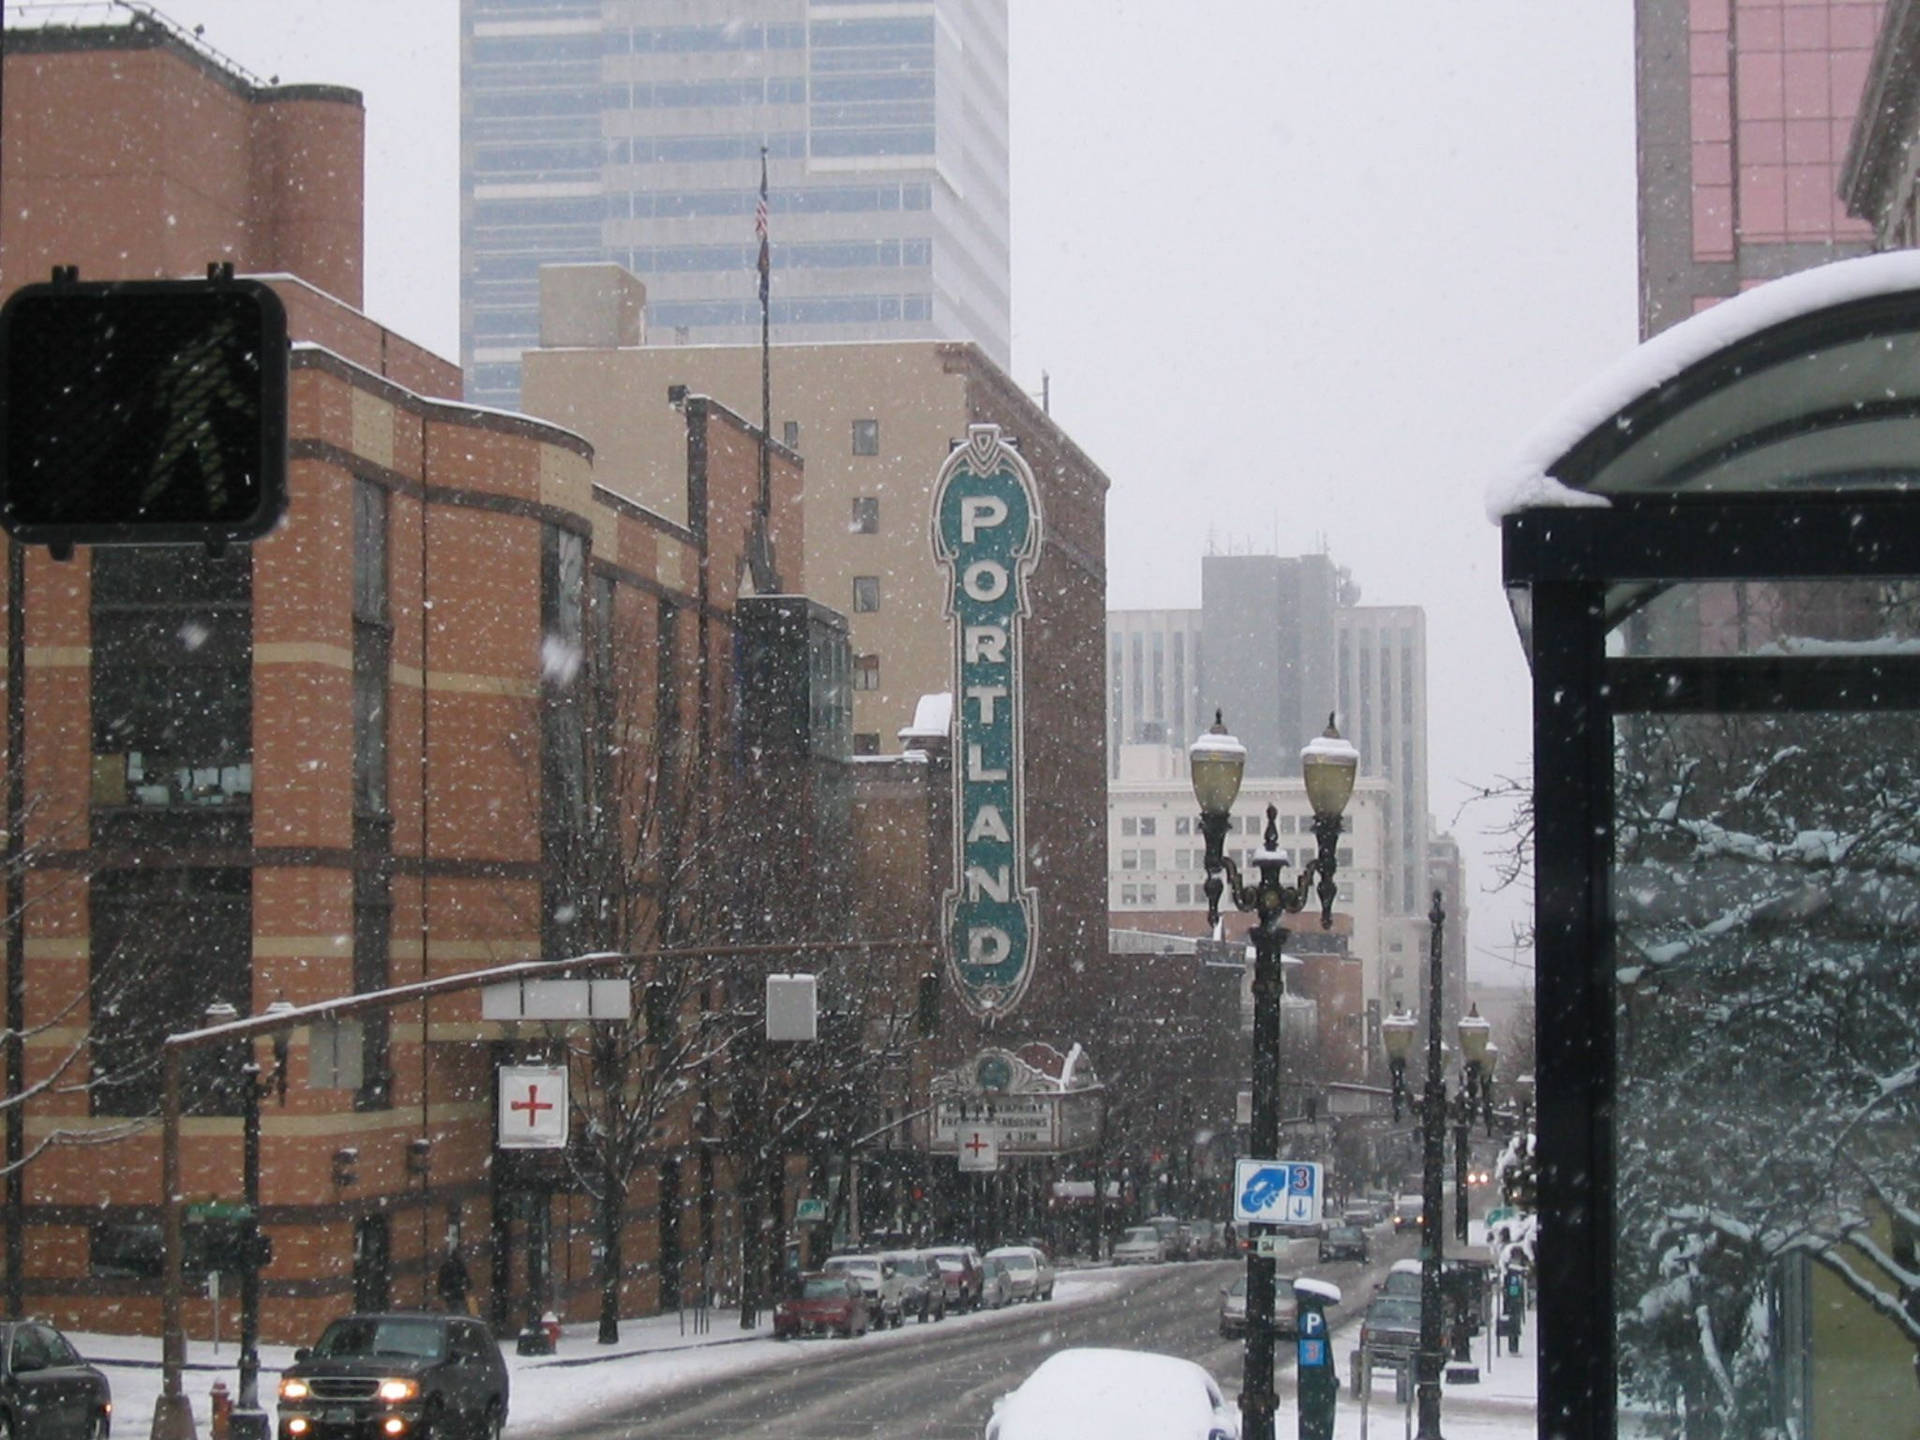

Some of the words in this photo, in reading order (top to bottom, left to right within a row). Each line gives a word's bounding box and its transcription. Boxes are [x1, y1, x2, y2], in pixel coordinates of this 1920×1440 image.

[960, 496, 1011, 966] PORTLAND
[1293, 1166, 1310, 1191] 3
[1306, 1312, 1321, 1335] P
[1306, 1341, 1319, 1361] 3
